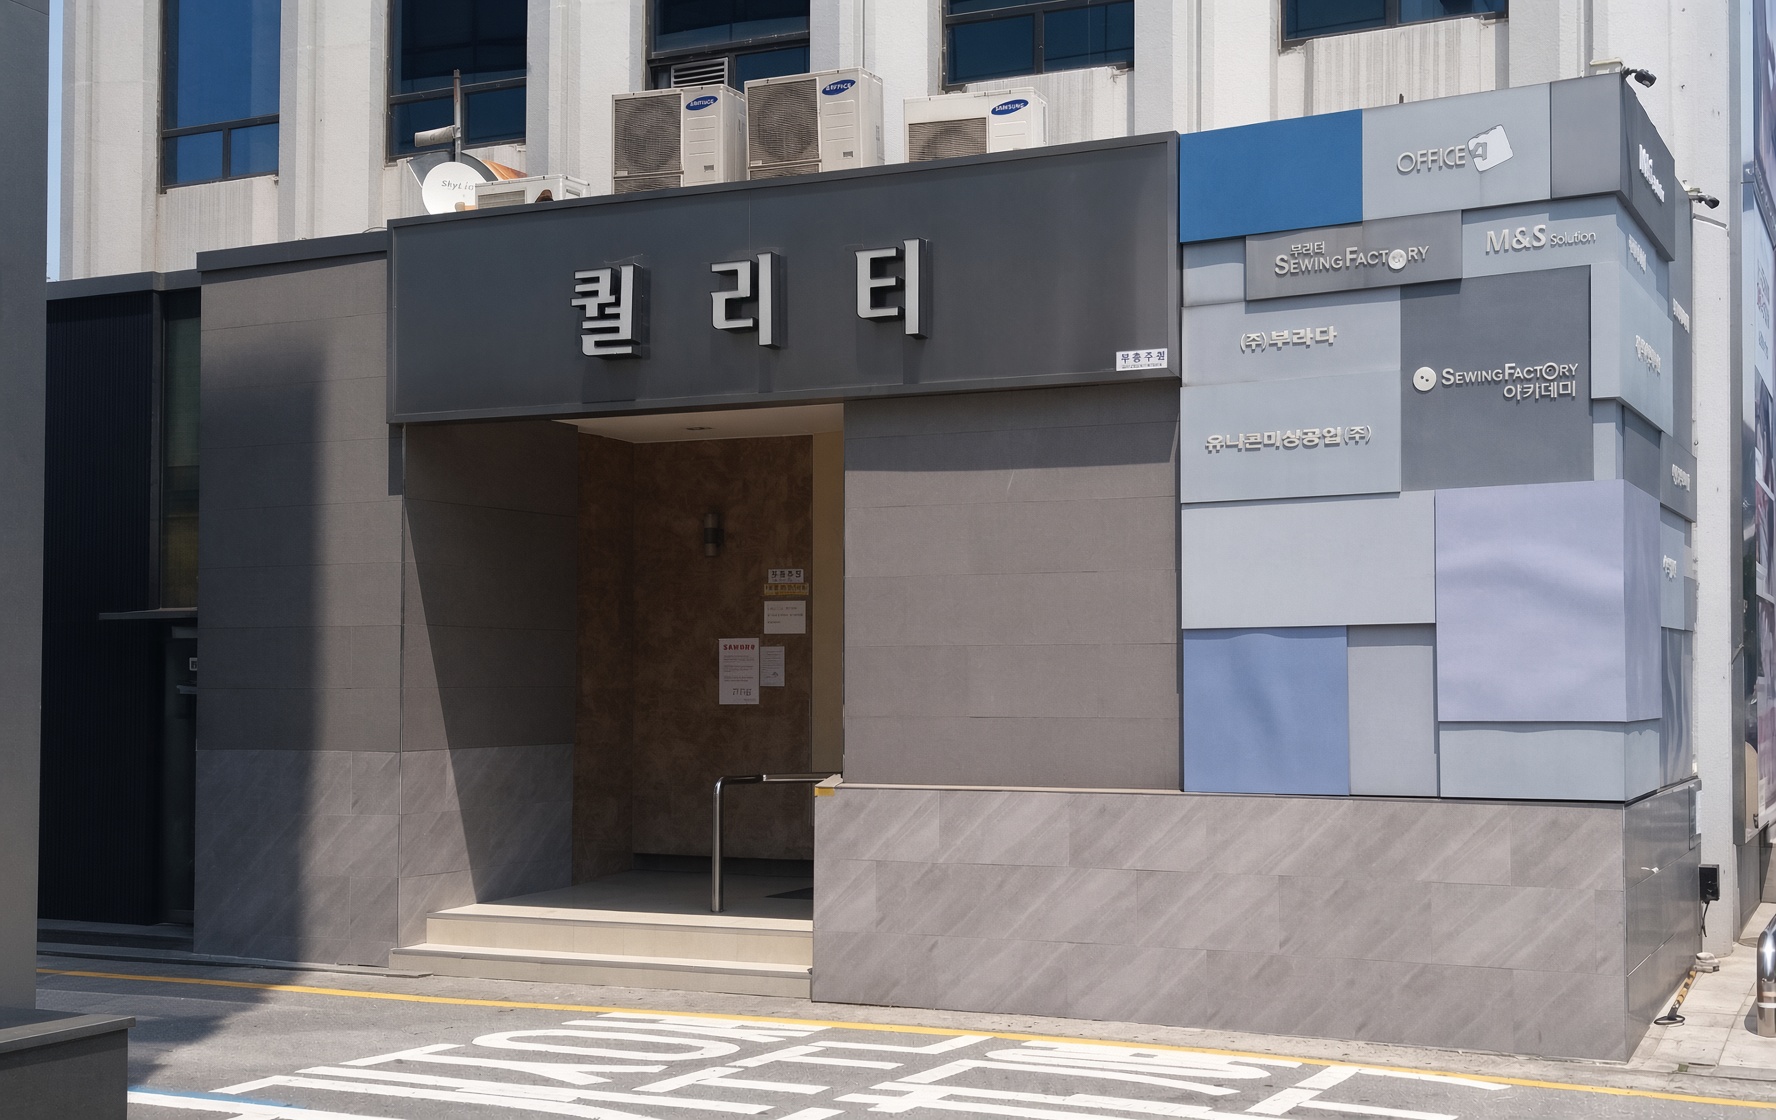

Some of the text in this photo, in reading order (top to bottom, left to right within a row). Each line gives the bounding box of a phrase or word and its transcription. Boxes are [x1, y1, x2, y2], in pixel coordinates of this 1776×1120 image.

[1397, 145, 1466, 172] OFFICE
[1290, 241, 1325, 257] 부리터
[1486, 225, 1597, 252] M&S Solution
